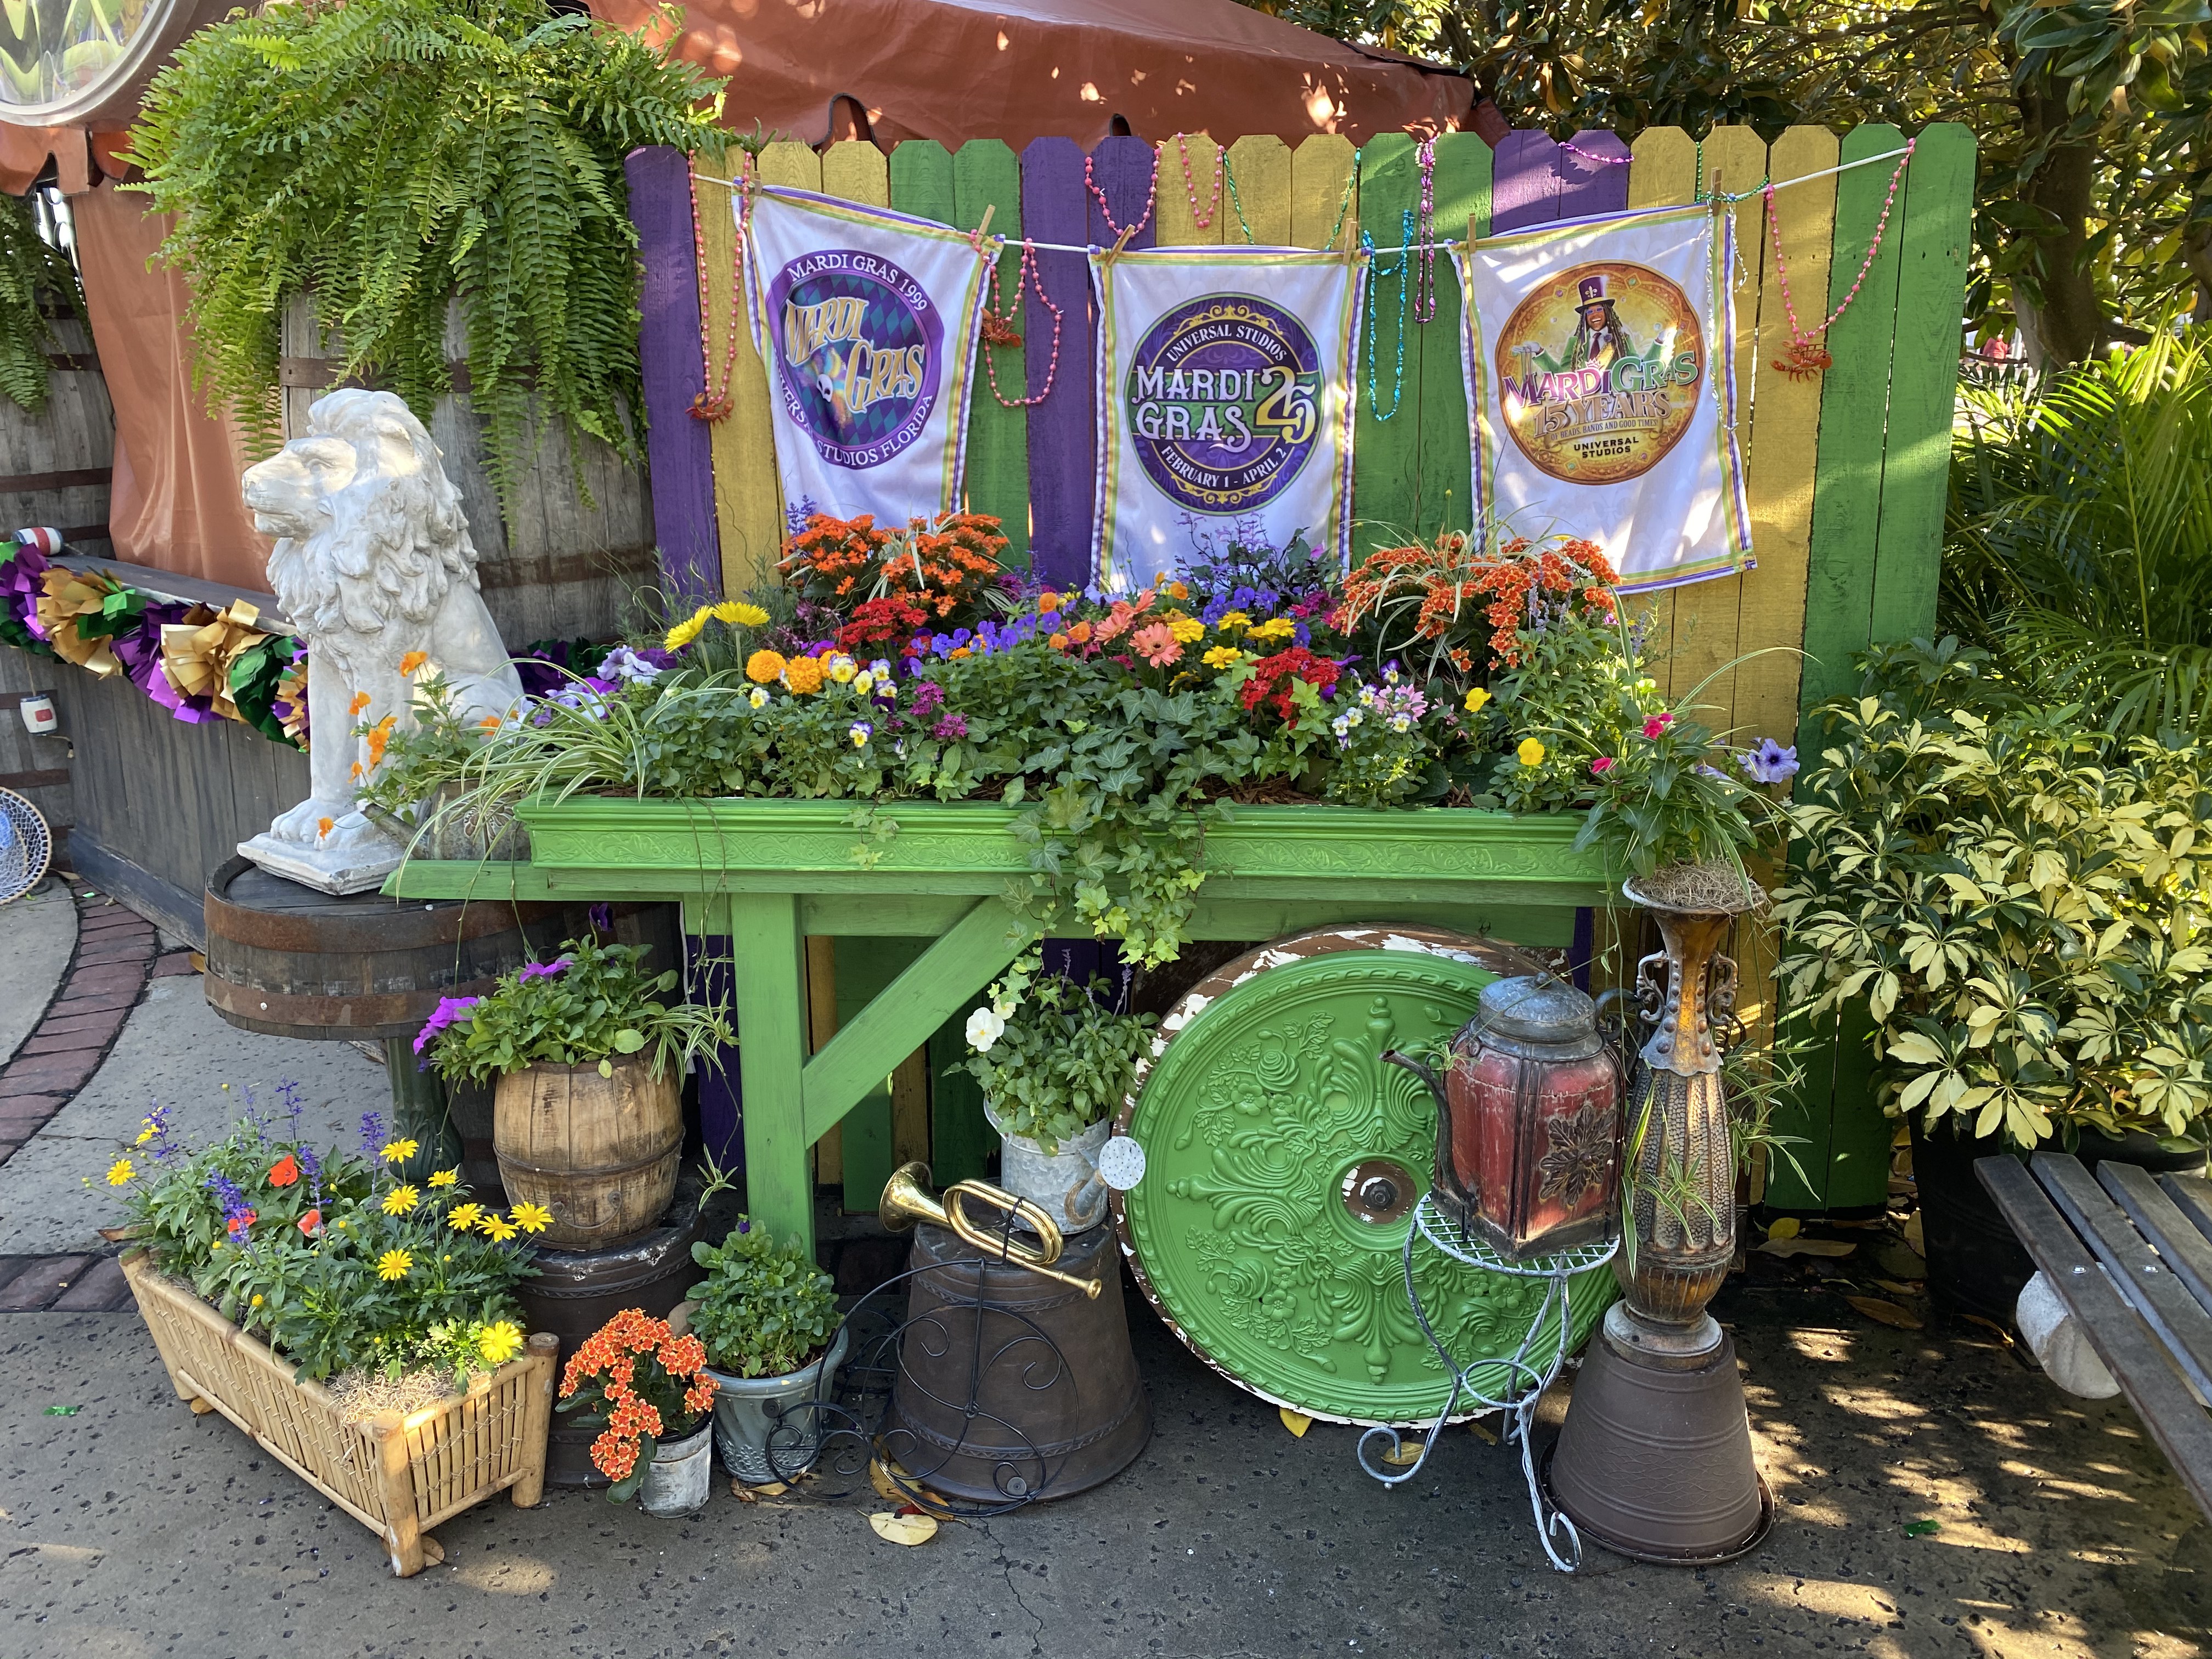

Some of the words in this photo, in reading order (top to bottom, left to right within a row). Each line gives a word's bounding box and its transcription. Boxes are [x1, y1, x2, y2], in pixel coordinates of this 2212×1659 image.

[787, 254, 848, 281] MARDI
[853, 255, 898, 284] GRAS
[898, 278, 928, 311] 1999
[1166, 324, 1232, 362] UNIVERSAL
[1237, 325, 1287, 361] STUDIOS
[845, 340, 925, 413] GRAS
[1131, 365, 1255, 404] MARDI
[1503, 368, 1611, 408] MARDI
[1611, 351, 1699, 394] GRAS
[1135, 402, 1251, 453] GRAS
[1256, 365, 1316, 444] 25
[1533, 400, 1570, 438] 15
[1570, 391, 1672, 426] YEARS
[1583, 424, 1603, 433] BANDS
[1605, 421, 1618, 430] AND
[1619, 420, 1636, 428] GOOD
[817, 440, 878, 466] STUDIOS
[880, 395, 932, 458] FLORIDA
[1574, 437, 1639, 451] UNIVERSAL
[1582, 446, 1631, 458] STUDIOS
[1161, 445, 1220, 487] FEBRUARY
[1224, 476, 1228, 487] 1
[1243, 460, 1278, 484] APRIL
[1276, 447, 1286, 458] 2
